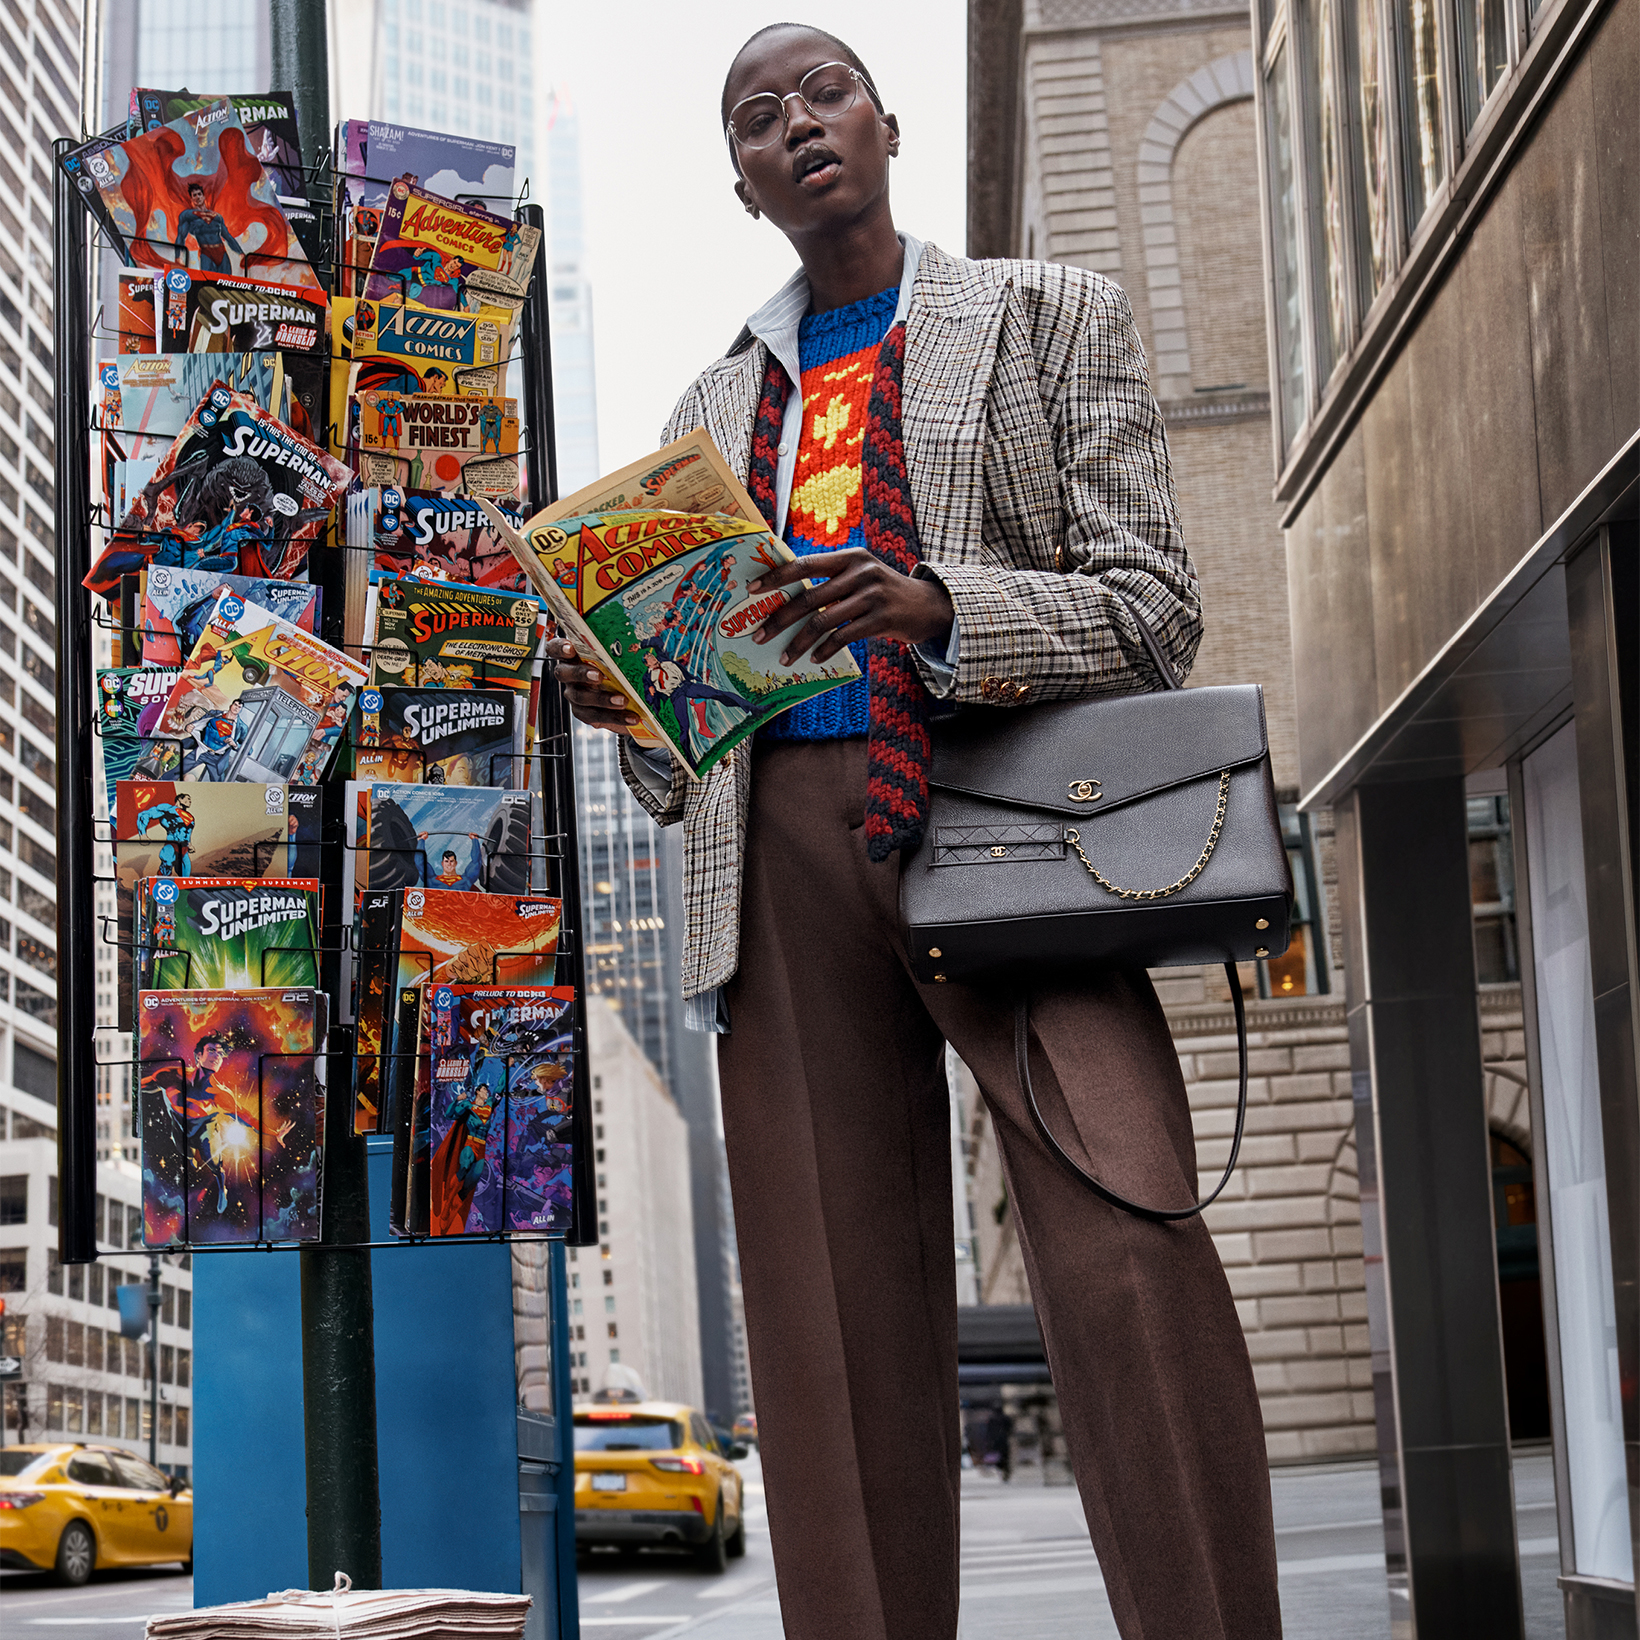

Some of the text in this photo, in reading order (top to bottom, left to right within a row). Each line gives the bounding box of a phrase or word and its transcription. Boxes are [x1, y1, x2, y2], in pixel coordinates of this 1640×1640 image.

[144, 99, 160, 110] DC
[195, 107, 228, 135] ACTION
[237, 105, 290, 124] RMAN
[369, 124, 404, 141] SHAZAM!
[408, 131, 439, 142] ADVENTURES
[501, 148, 514, 158] DC
[65, 158, 80, 171] DC
[412, 188, 468, 215] SUPERGIRL
[285, 212, 316, 221] UPERMAN
[388, 206, 402, 220] 15¢
[401, 204, 502, 254] Adventure
[436, 233, 475, 254] COMICS
[172, 276, 186, 287] DC
[216, 279, 254, 292] PRELUDE
[255, 284, 266, 293] TO
[210, 299, 317, 335] SUPERMAN
[378, 305, 479, 341] ACTION
[275, 331, 317, 348] DARKSEID
[355, 330, 374, 339] ACTION
[404, 340, 463, 362] COMICS
[124, 358, 172, 378] ACTION
[263, 358, 276, 367] DC
[213, 390, 229, 407] DC
[401, 401, 480, 426] WORLD'S
[257, 418, 307, 455] IS THIS THE END
[364, 433, 378, 444] 15¢
[409, 425, 471, 448] FINEST
[645, 453, 701, 497] SUPERMAN
[385, 495, 399, 504] DC
[415, 507, 525, 545] SUPERAN
[534, 529, 564, 547] DC
[576, 516, 707, 617] ACTION
[595, 527, 723, 591] COMICS
[156, 575, 168, 583] DC
[152, 588, 162, 596] ALL
[271, 588, 309, 602] SUPERMAN
[414, 587, 424, 596] THE
[424, 587, 454, 600] AMAZING
[454, 591, 495, 605] ADVENTURES
[627, 591, 641, 603] THIS
[651, 578, 663, 587] JOB
[226, 603, 238, 614] DC
[720, 591, 787, 638] SUPERMAN!
[211, 618, 239, 632] ALL IN
[414, 610, 515, 644] SUPERMAN
[215, 623, 350, 690] ACTION
[458, 642, 503, 652] ELECTRONIC
[503, 645, 527, 657] GHOST
[105, 679, 121, 688] DC
[127, 672, 180, 697] SUP
[296, 676, 330, 697] COMICS
[276, 692, 318, 724] TELEPHONE
[364, 695, 378, 708] DC
[404, 702, 505, 738] SUPERMAN
[421, 716, 505, 745] UNLIMITED
[360, 755, 383, 765] ALL IN
[378, 790, 390, 798] DC
[266, 807, 276, 815] ALL
[159, 886, 173, 898] DC
[411, 896, 421, 905] DC
[201, 897, 307, 936] SUPERMAN
[519, 903, 555, 917] SUPERMAN
[221, 909, 307, 941] UNLIMITED
[153, 950, 170, 959] ALL
[144, 998, 158, 1007] DC
[402, 993, 415, 1002] DC
[439, 994, 451, 1006] DC
[436, 1065, 470, 1078] DARKSEID
[533, 1214, 555, 1225] ALL IN
